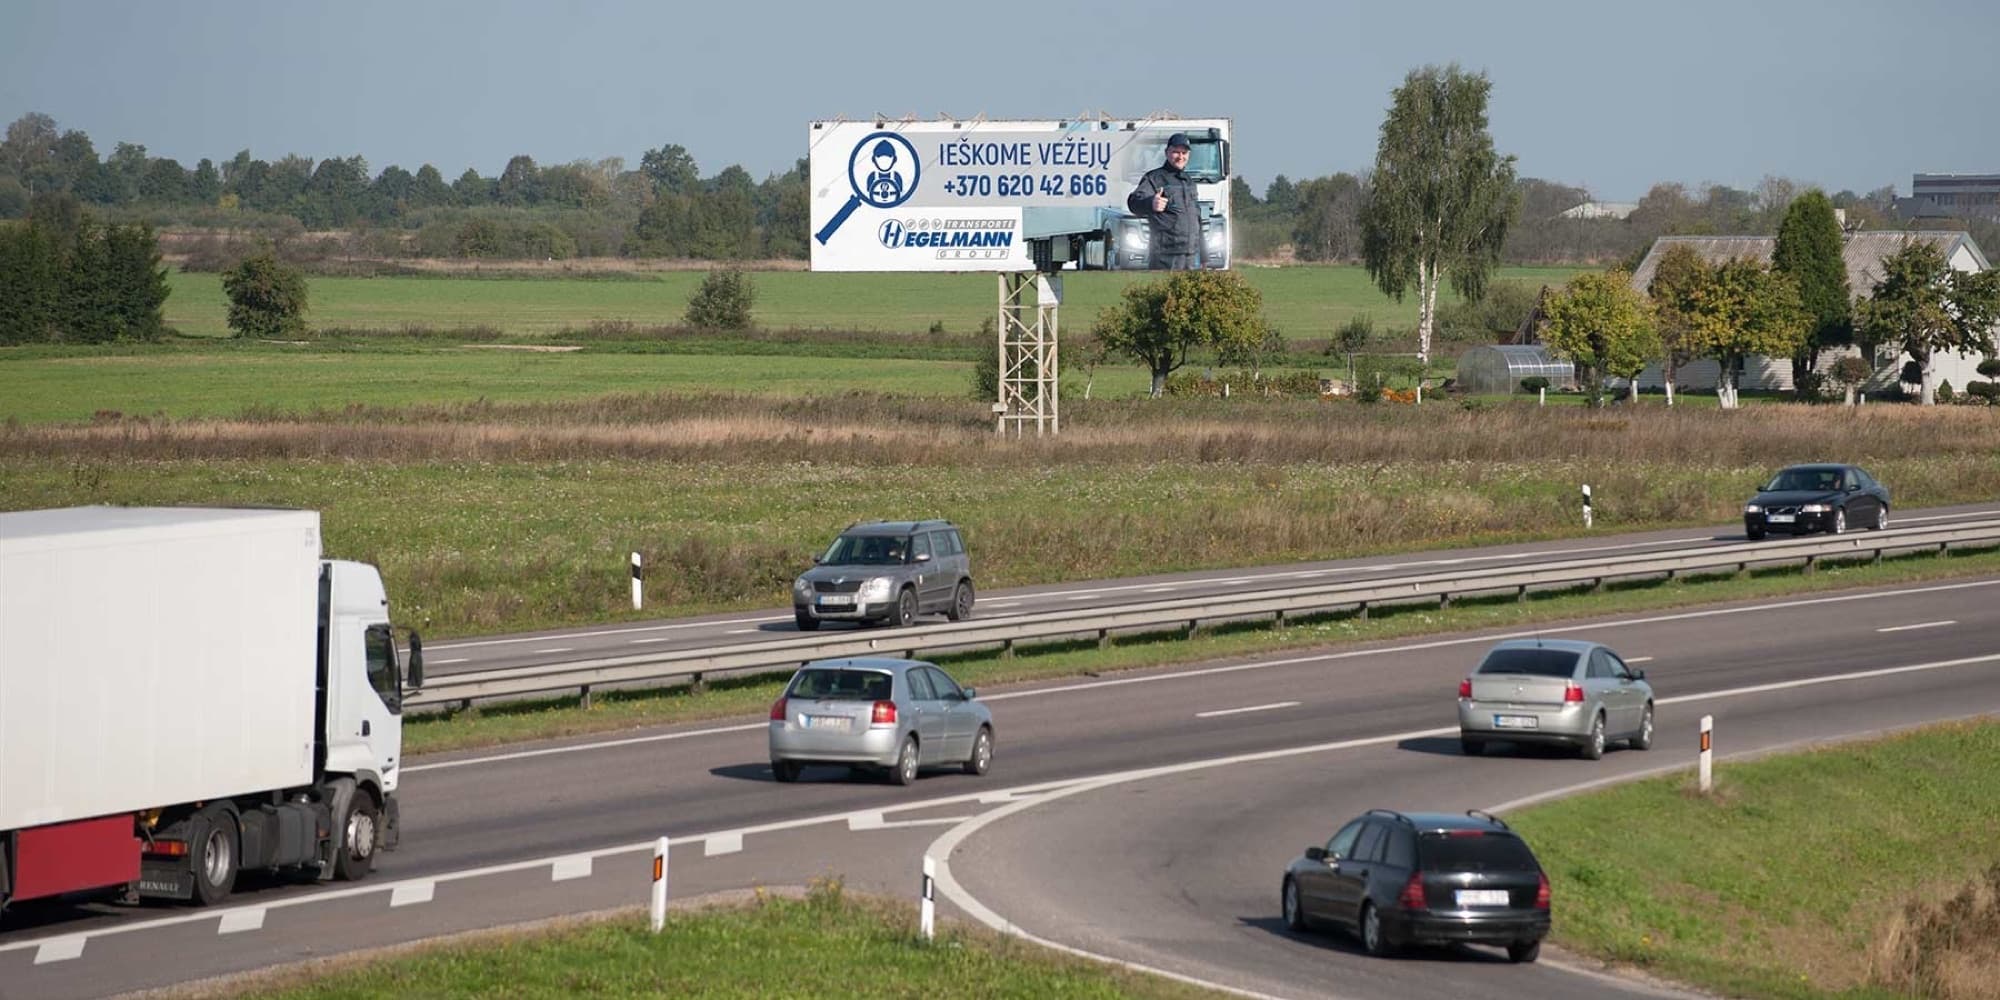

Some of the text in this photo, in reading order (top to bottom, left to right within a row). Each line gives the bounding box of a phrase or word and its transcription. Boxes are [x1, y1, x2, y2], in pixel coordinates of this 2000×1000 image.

[939, 137, 1111, 170] IEŠKOME VEŽĖJŲ
[944, 174, 1107, 196] +370 620 42 666
[945, 219, 1014, 230] TRANSPORTE
[881, 220, 1013, 248] HEGELMANN
[939, 250, 1007, 259] GROUP
[140, 880, 178, 892] RENAULT
